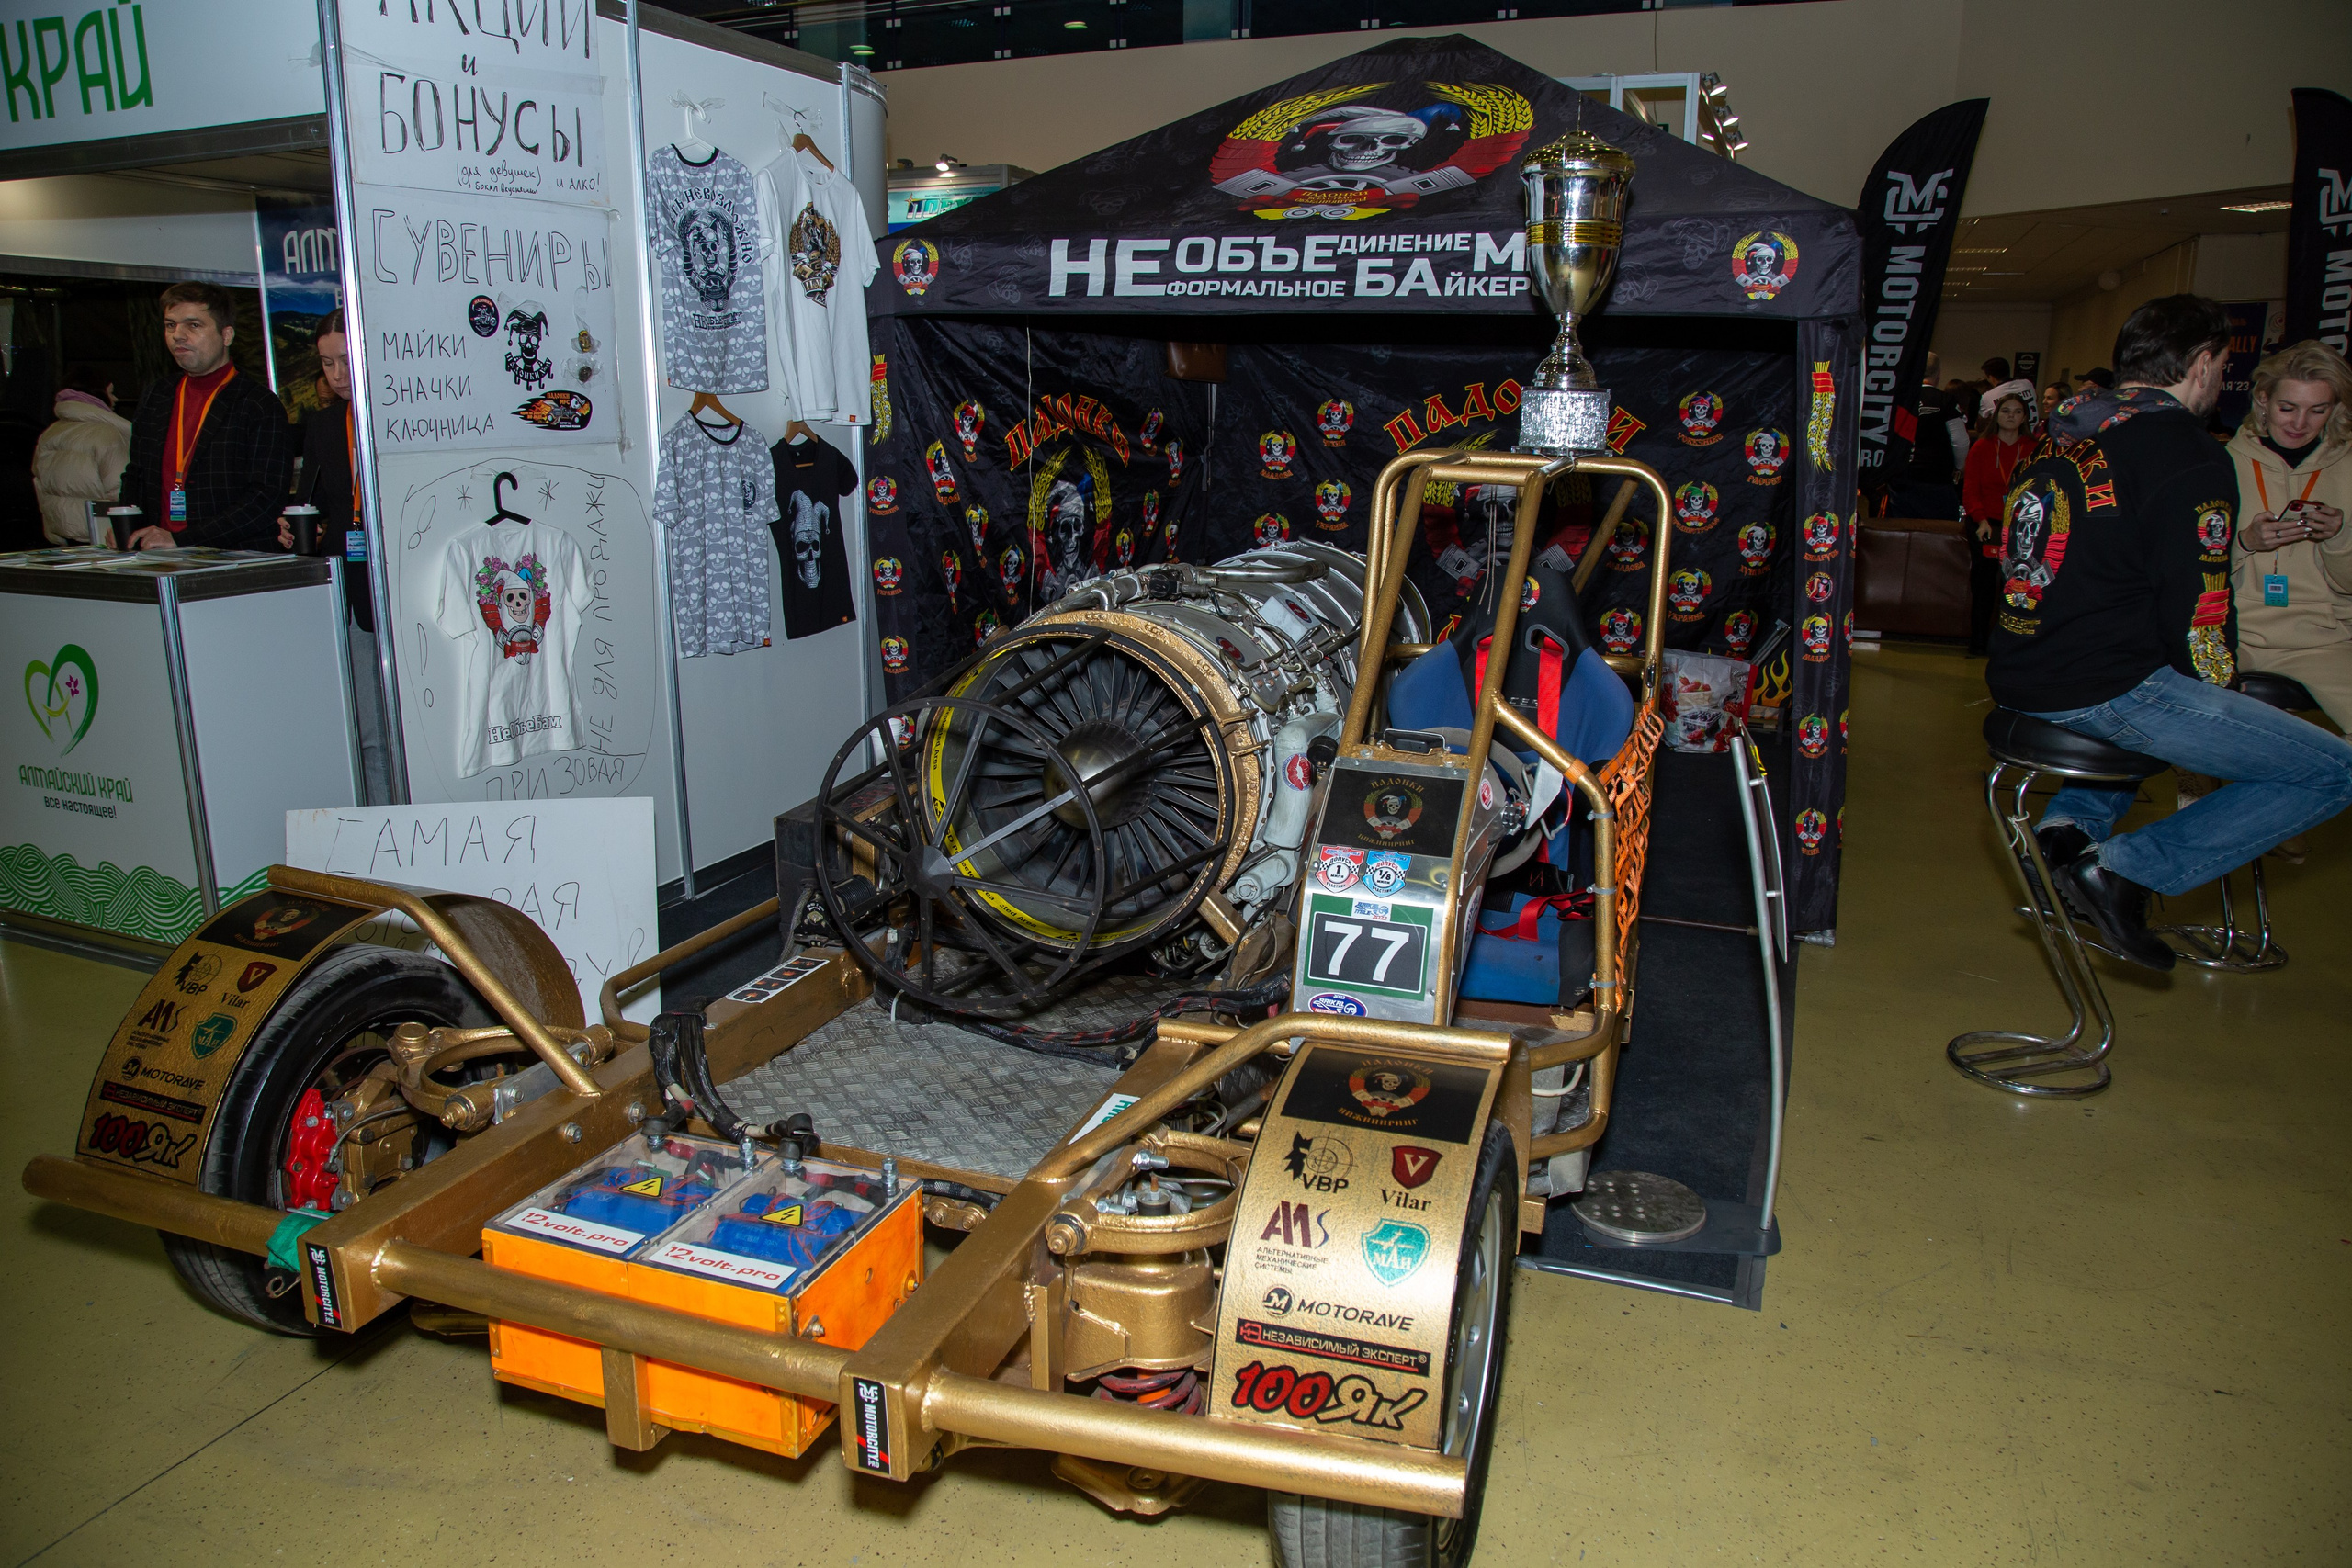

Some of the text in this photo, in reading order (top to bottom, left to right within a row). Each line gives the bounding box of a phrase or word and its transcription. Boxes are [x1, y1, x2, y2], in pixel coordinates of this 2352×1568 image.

[379, 0, 590, 59] ЦИИ
[0, 0, 153, 122] КРАЙ
[380, 72, 583, 167] БОНУСЫ
[457, 160, 542, 186] (для девушек)
[569, 173, 600, 192] АЛКО!
[372, 209, 611, 293] СУВЕНИРЫ
[1166, 258, 1532, 297] ФОРМАЛЬНОЕ БАЙКЕР
[382, 329, 468, 363] МАЙКИ
[1858, 244, 1926, 457] MOTORCITY
[381, 375, 472, 407] ЗНАЧКИ
[386, 414, 495, 443] КЛЮЧНИЦА
[1383, 378, 1648, 456] ПАДОИ
[1259, 468, 1294, 480] МАЛДОВА
[876, 587, 903, 596] УКРАИНА
[1667, 610, 1706, 623] УКРАИНА
[19, 764, 134, 804] АЛТАЙСКИЙ КРАЙ
[1370, 777, 1425, 794] ПАДОНКИ
[44, 795, 119, 819] все настоящее!
[325, 815, 537, 874] САМАЯ
[1329, 856, 1352, 865] ДОПУСК
[1336, 864, 1342, 874] 1
[1375, 861, 1399, 871] ДОПУСК
[1378, 869, 1392, 881] 1/8
[1017, 915, 1037, 929] Area
[1324, 920, 1410, 982] 77
[179, 980, 209, 997] VBP
[220, 992, 251, 1010] Vilar
[1318, 998, 1345, 1007] BAIKAL
[140, 1067, 206, 1091] MOTORAVE
[1361, 1058, 1435, 1076] ПАДОНКИ
[1337, 1106, 1419, 1127] ИНЖИНИРИНГ
[1301, 1171, 1351, 1195] VBP
[1380, 1189, 1433, 1212] Vilar
[520, 1211, 629, 1247] 12volt.pro
[664, 1245, 781, 1281] 12volt.pro
[1255, 1254, 1317, 1269] МЕХАНИЧЕСКИЕ
[1256, 1247, 1329, 1264] АЛЬТЕРНАТИВНЫЕ
[1254, 1262, 1294, 1274] СИСТЕМЫ
[316, 1266, 334, 1318] MOTORCITY
[1296, 1299, 1415, 1332] MOTORAVE
[1262, 1328, 1361, 1359] НЕЗАВИСИМЫЙ
[864, 1403, 880, 1462] MOTORCITY
